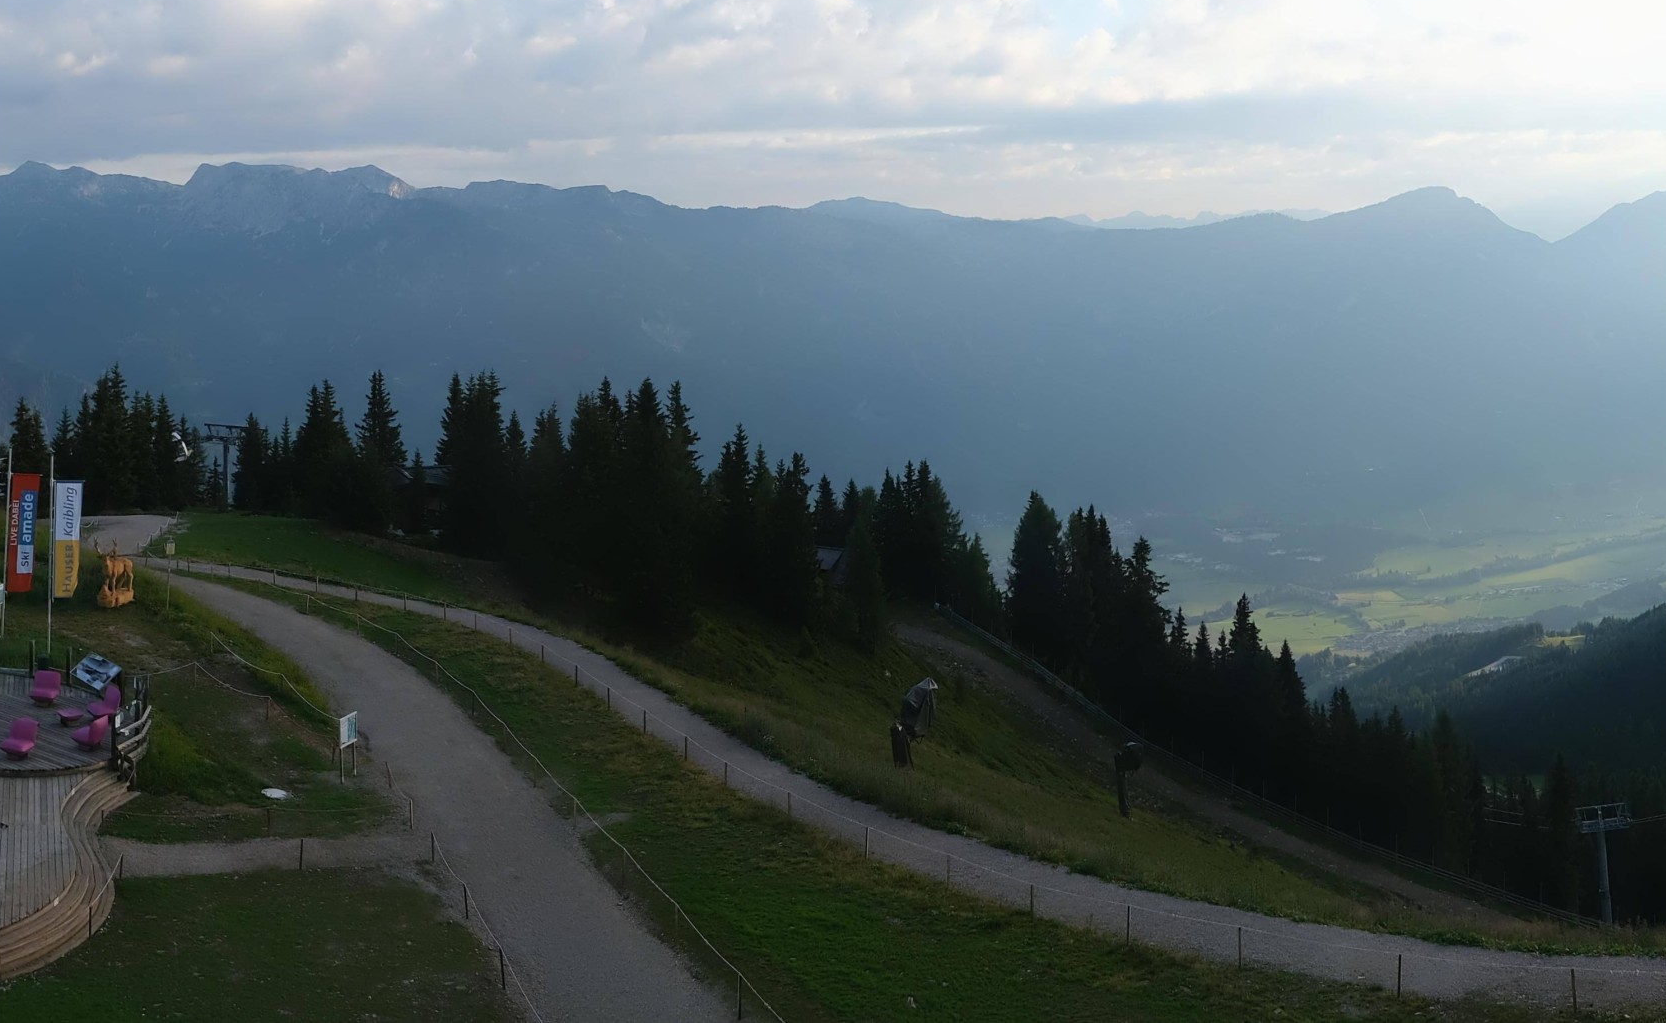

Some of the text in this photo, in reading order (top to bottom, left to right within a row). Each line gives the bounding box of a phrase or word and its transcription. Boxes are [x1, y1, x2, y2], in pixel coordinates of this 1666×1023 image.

[10, 499, 20, 546] LIVE DABEI
[20, 492, 34, 567] Ski amade
[62, 487, 77, 592] HAUSER Kaibling
